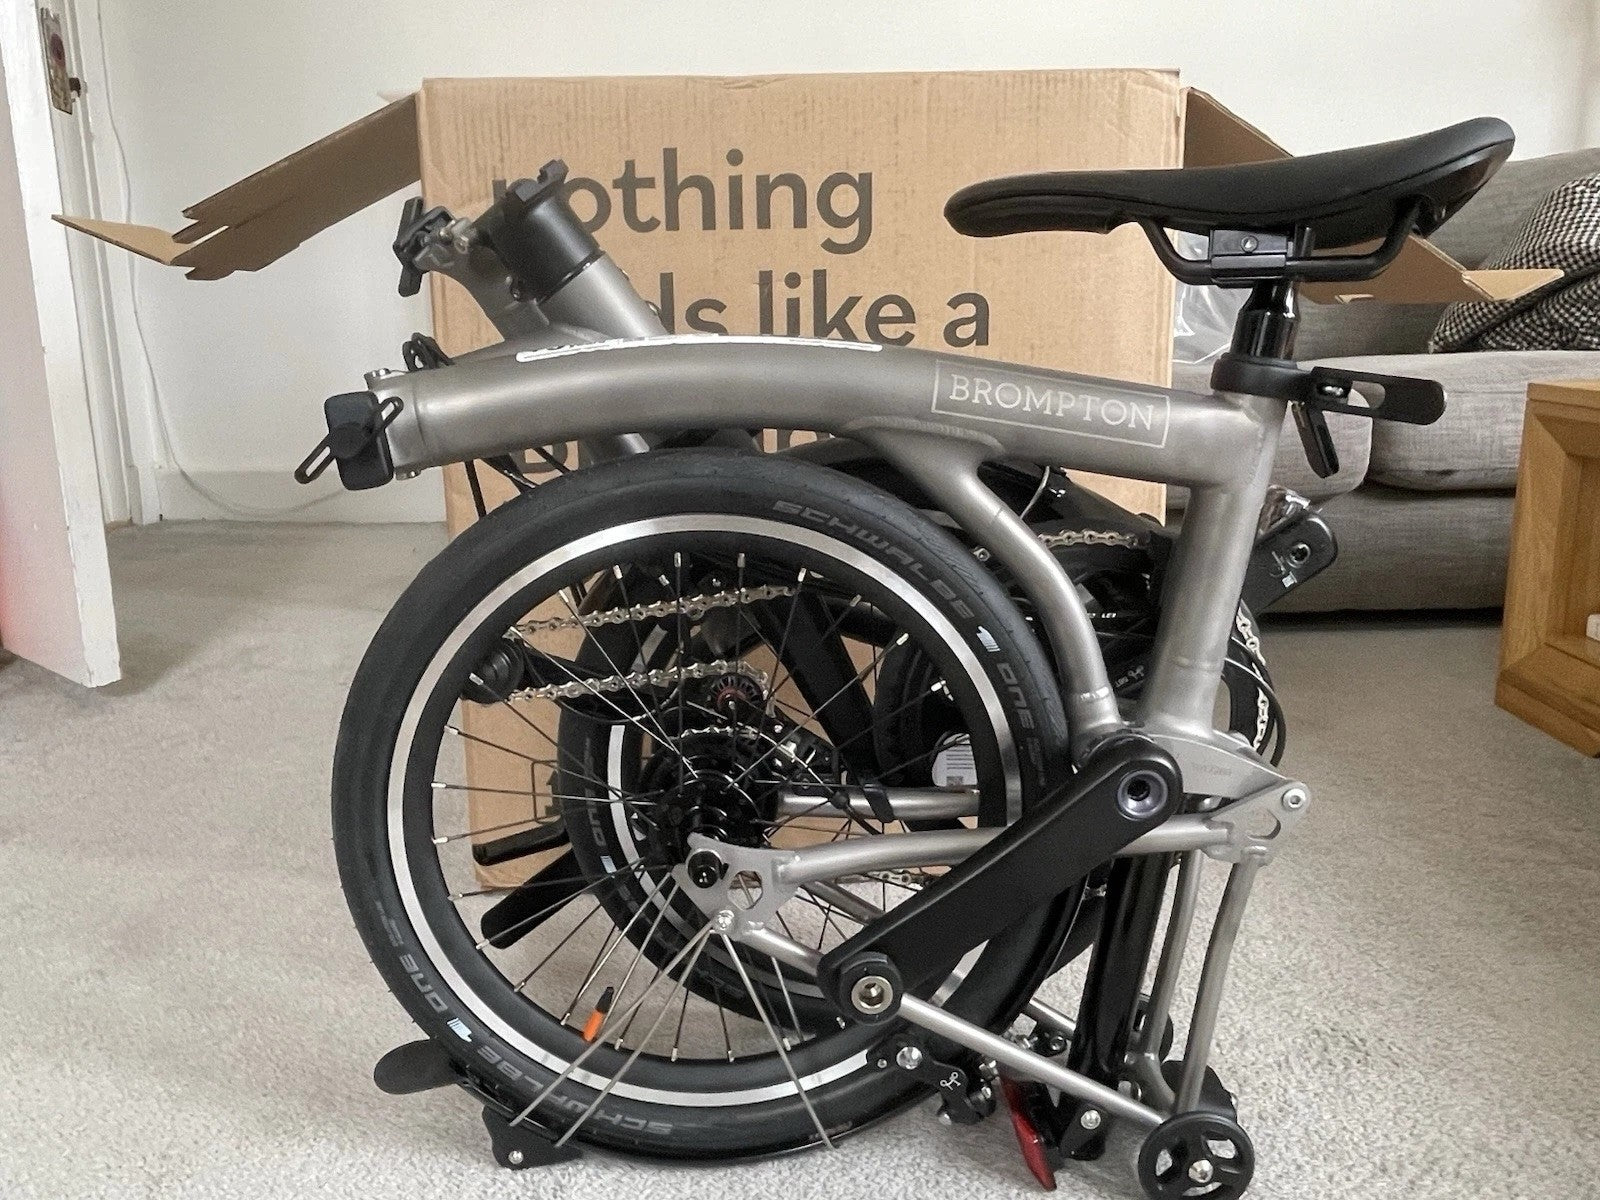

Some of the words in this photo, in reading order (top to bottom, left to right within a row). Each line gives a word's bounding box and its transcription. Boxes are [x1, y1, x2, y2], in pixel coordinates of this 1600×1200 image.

[492, 147, 873, 254] othing
[759, 268, 916, 347] like
[943, 292, 989, 348] a
[949, 374, 1154, 430] BROMPTON
[773, 501, 975, 619] SCHWALBE
